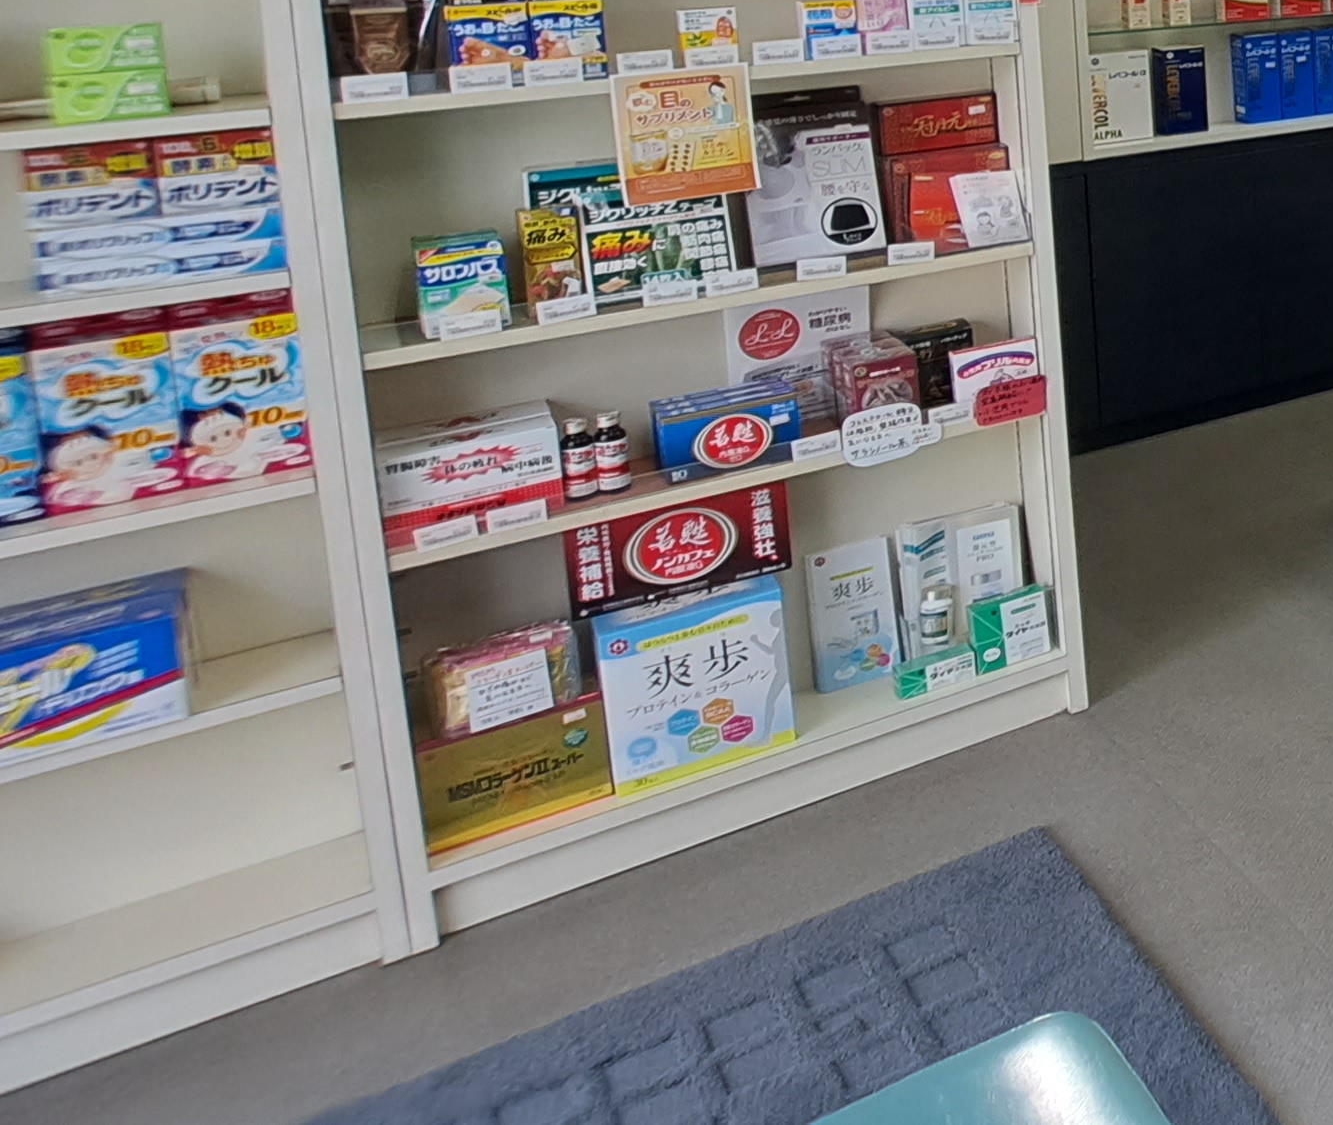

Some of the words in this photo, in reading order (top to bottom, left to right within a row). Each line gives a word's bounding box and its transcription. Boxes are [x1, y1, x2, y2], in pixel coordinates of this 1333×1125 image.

[660, 90, 692, 109] 目の
[636, 109, 713, 127] サプリメント
[1094, 129, 1123, 141] ALPHA
[168, 176, 278, 203] ポリデント
[820, 180, 870, 197] 腰を守る
[32, 191, 152, 217] ポリデント
[424, 257, 501, 283] サロンパス
[210, 368, 285, 395] クール
[75, 389, 152, 416] クール
[444, 456, 500, 476] 体の疲れ
[576, 526, 605, 602] 栄養補給
[651, 549, 716, 572] ノンカフェ
[642, 638, 750, 700] 爽歩
